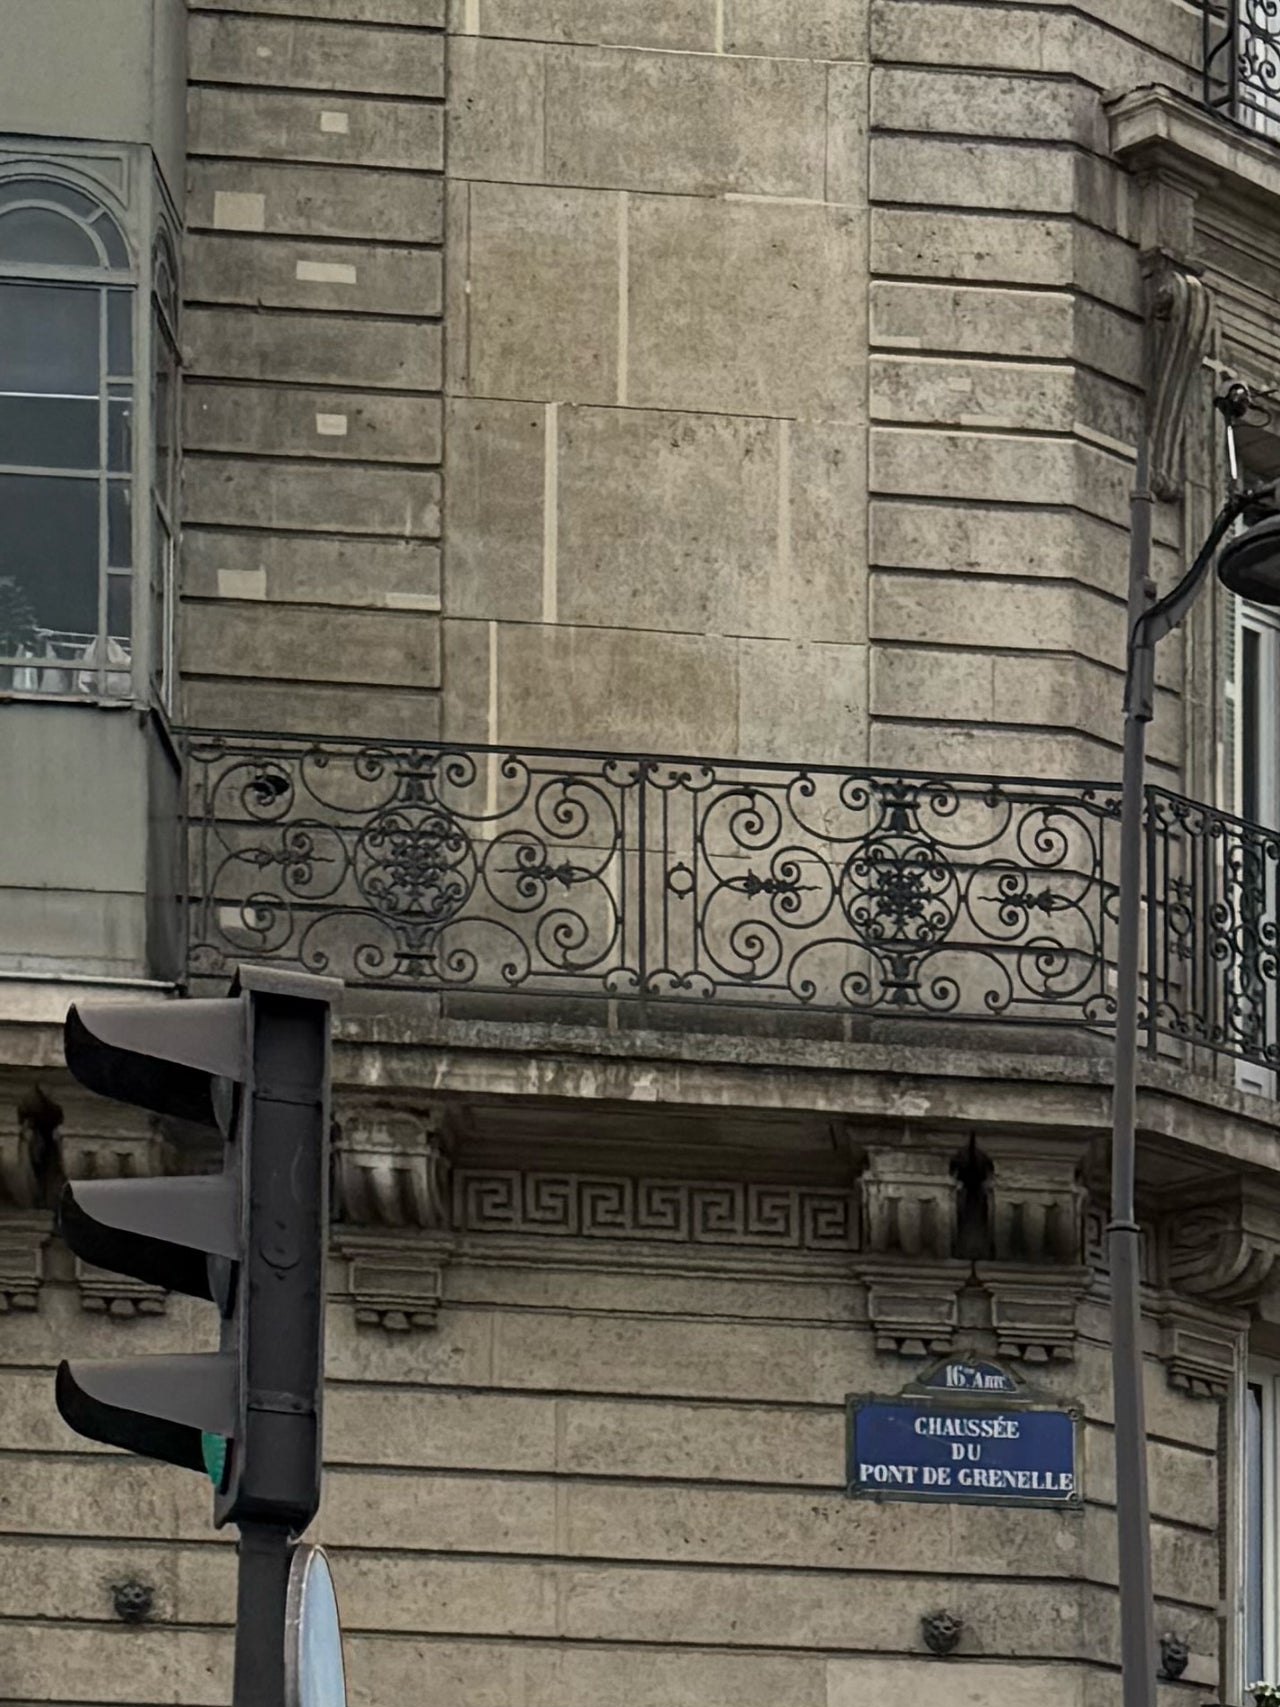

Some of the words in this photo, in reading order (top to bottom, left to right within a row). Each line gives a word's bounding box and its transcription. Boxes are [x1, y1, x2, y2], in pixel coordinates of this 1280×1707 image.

[914, 1415, 1020, 1439] CHAUSSÉE
[951, 1442, 981, 1461] DU
[859, 1464, 918, 1484] PONT
[922, 1467, 950, 1486] DE
[957, 1469, 1073, 1490] GRENELLE
